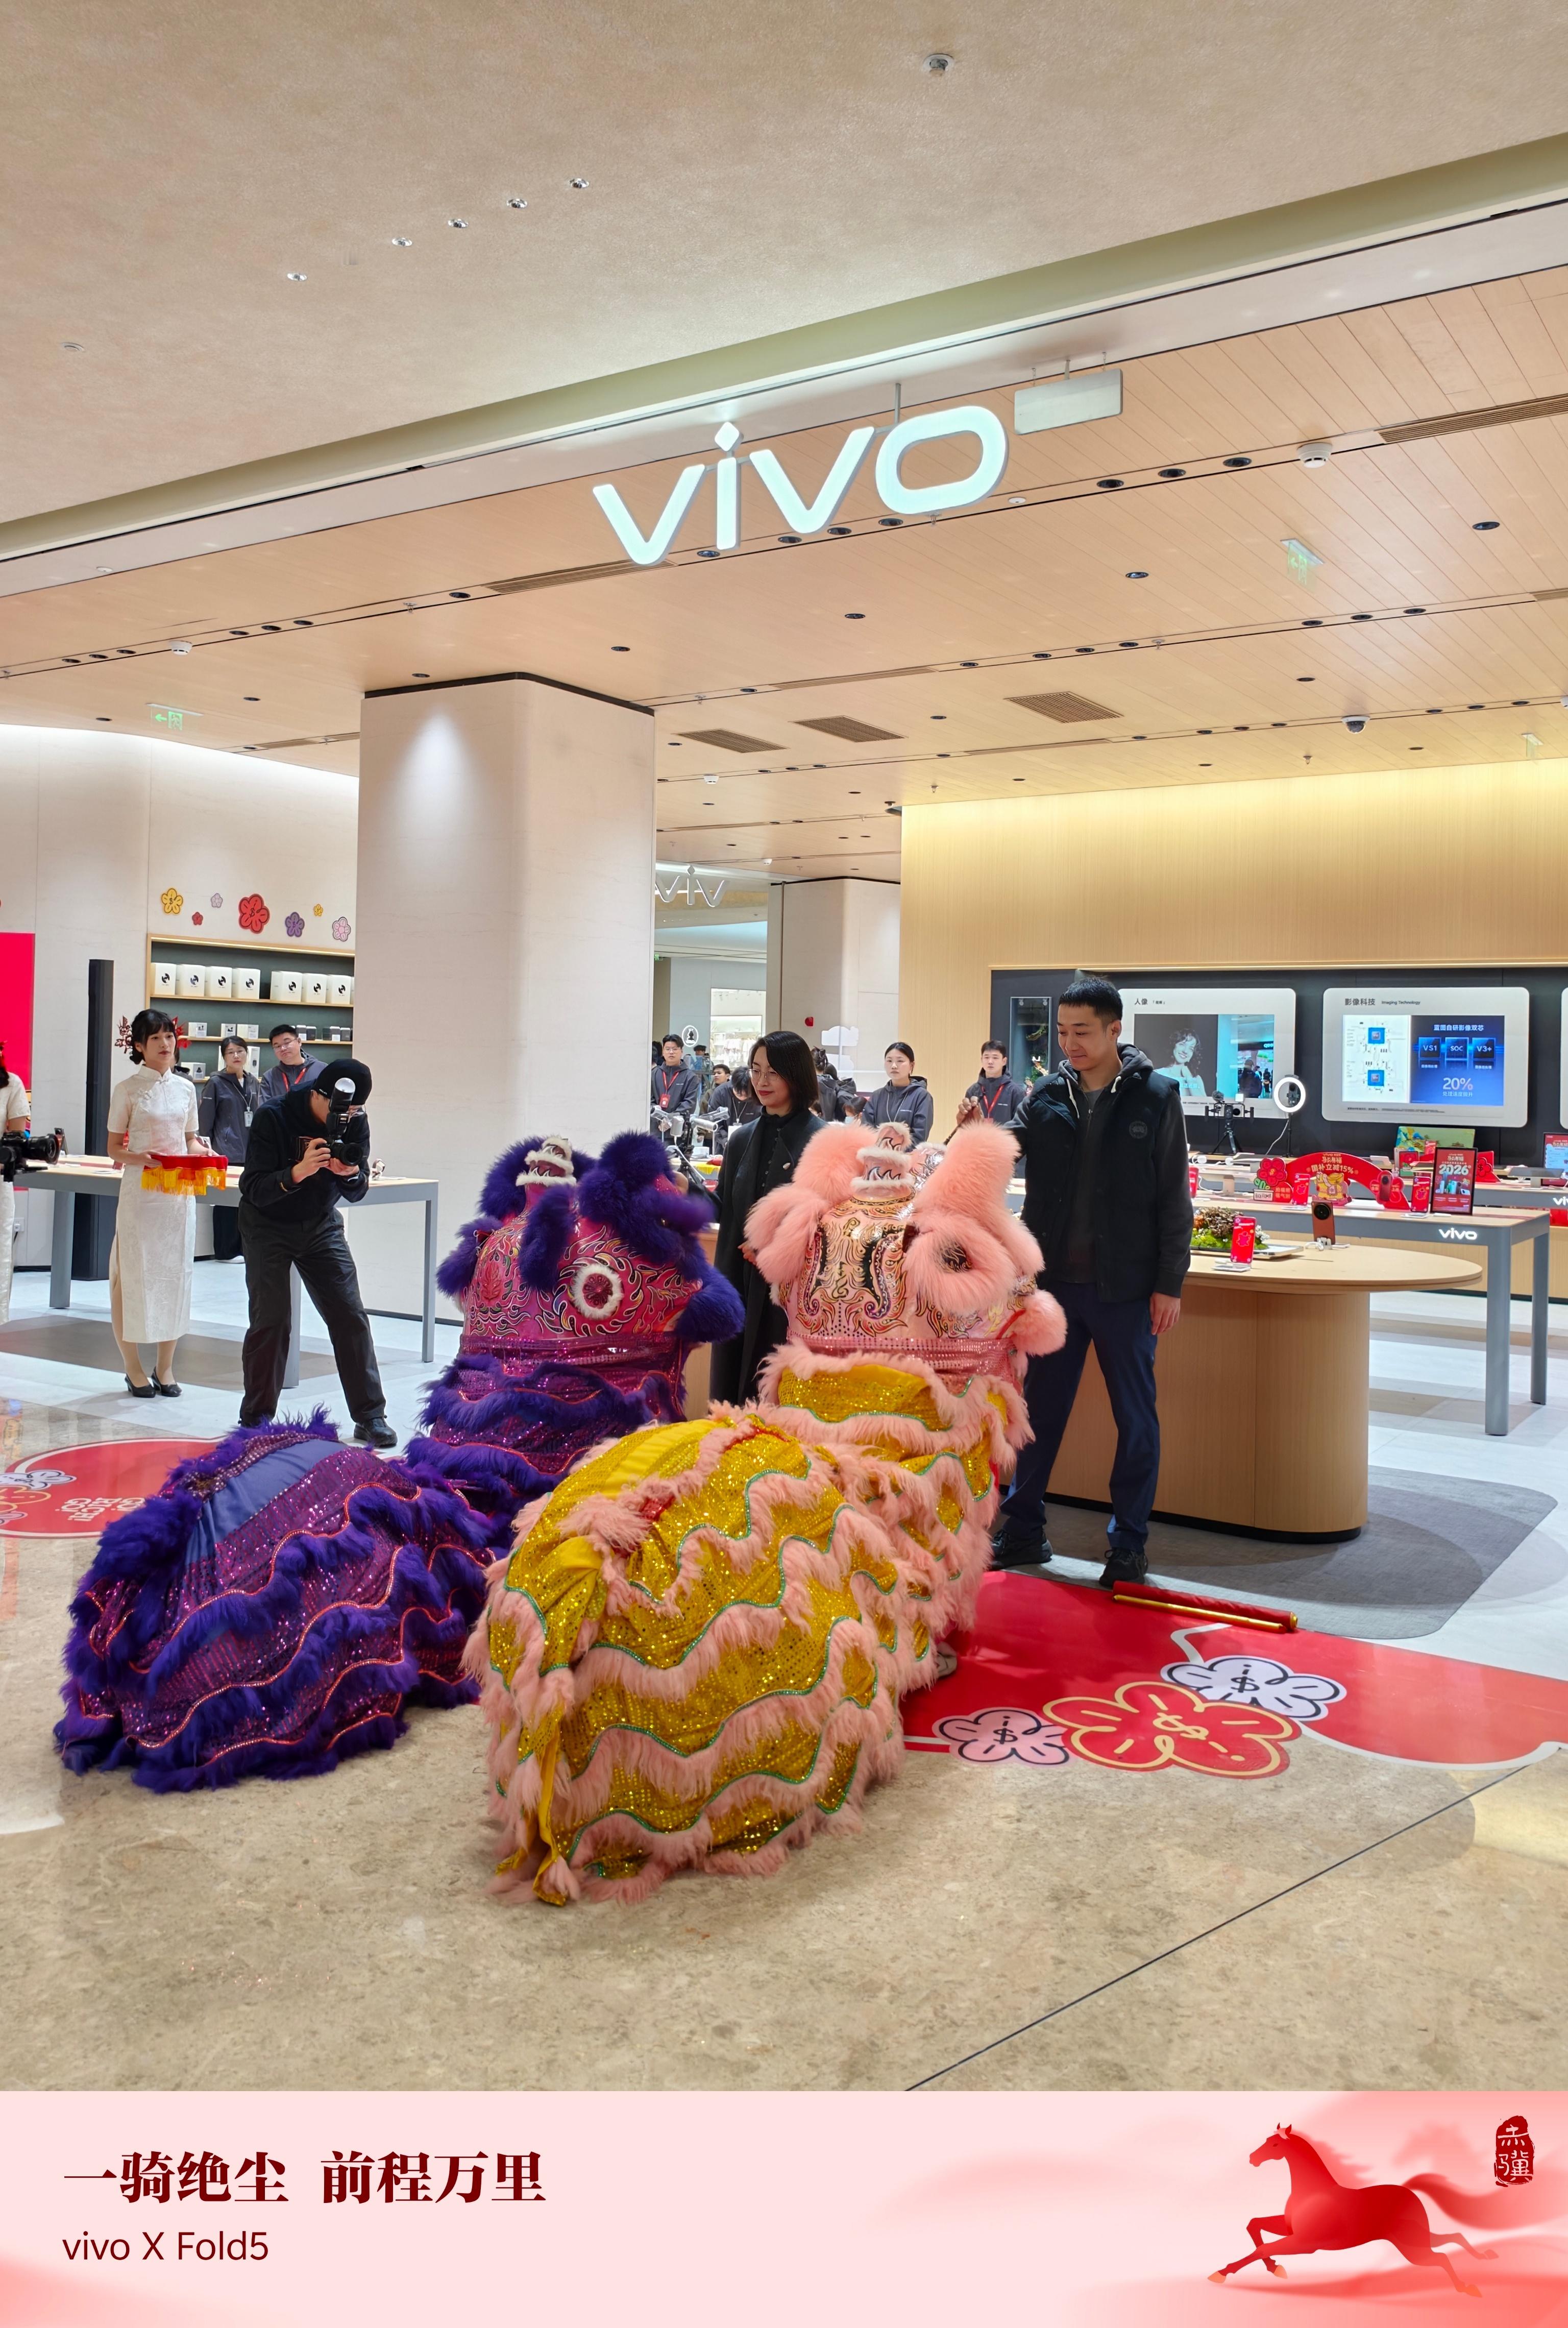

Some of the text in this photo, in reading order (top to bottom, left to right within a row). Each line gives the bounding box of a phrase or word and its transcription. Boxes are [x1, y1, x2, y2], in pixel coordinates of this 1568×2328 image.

[593, 405, 1009, 566] vivo
[1344, 998, 1376, 1006] 影像科技
[1442, 1077, 1474, 1090] 20%
[1439, 1164, 1469, 1176] 2026
[1553, 1196, 1568, 1206] vi
[1438, 1227, 1478, 1240] vivo
